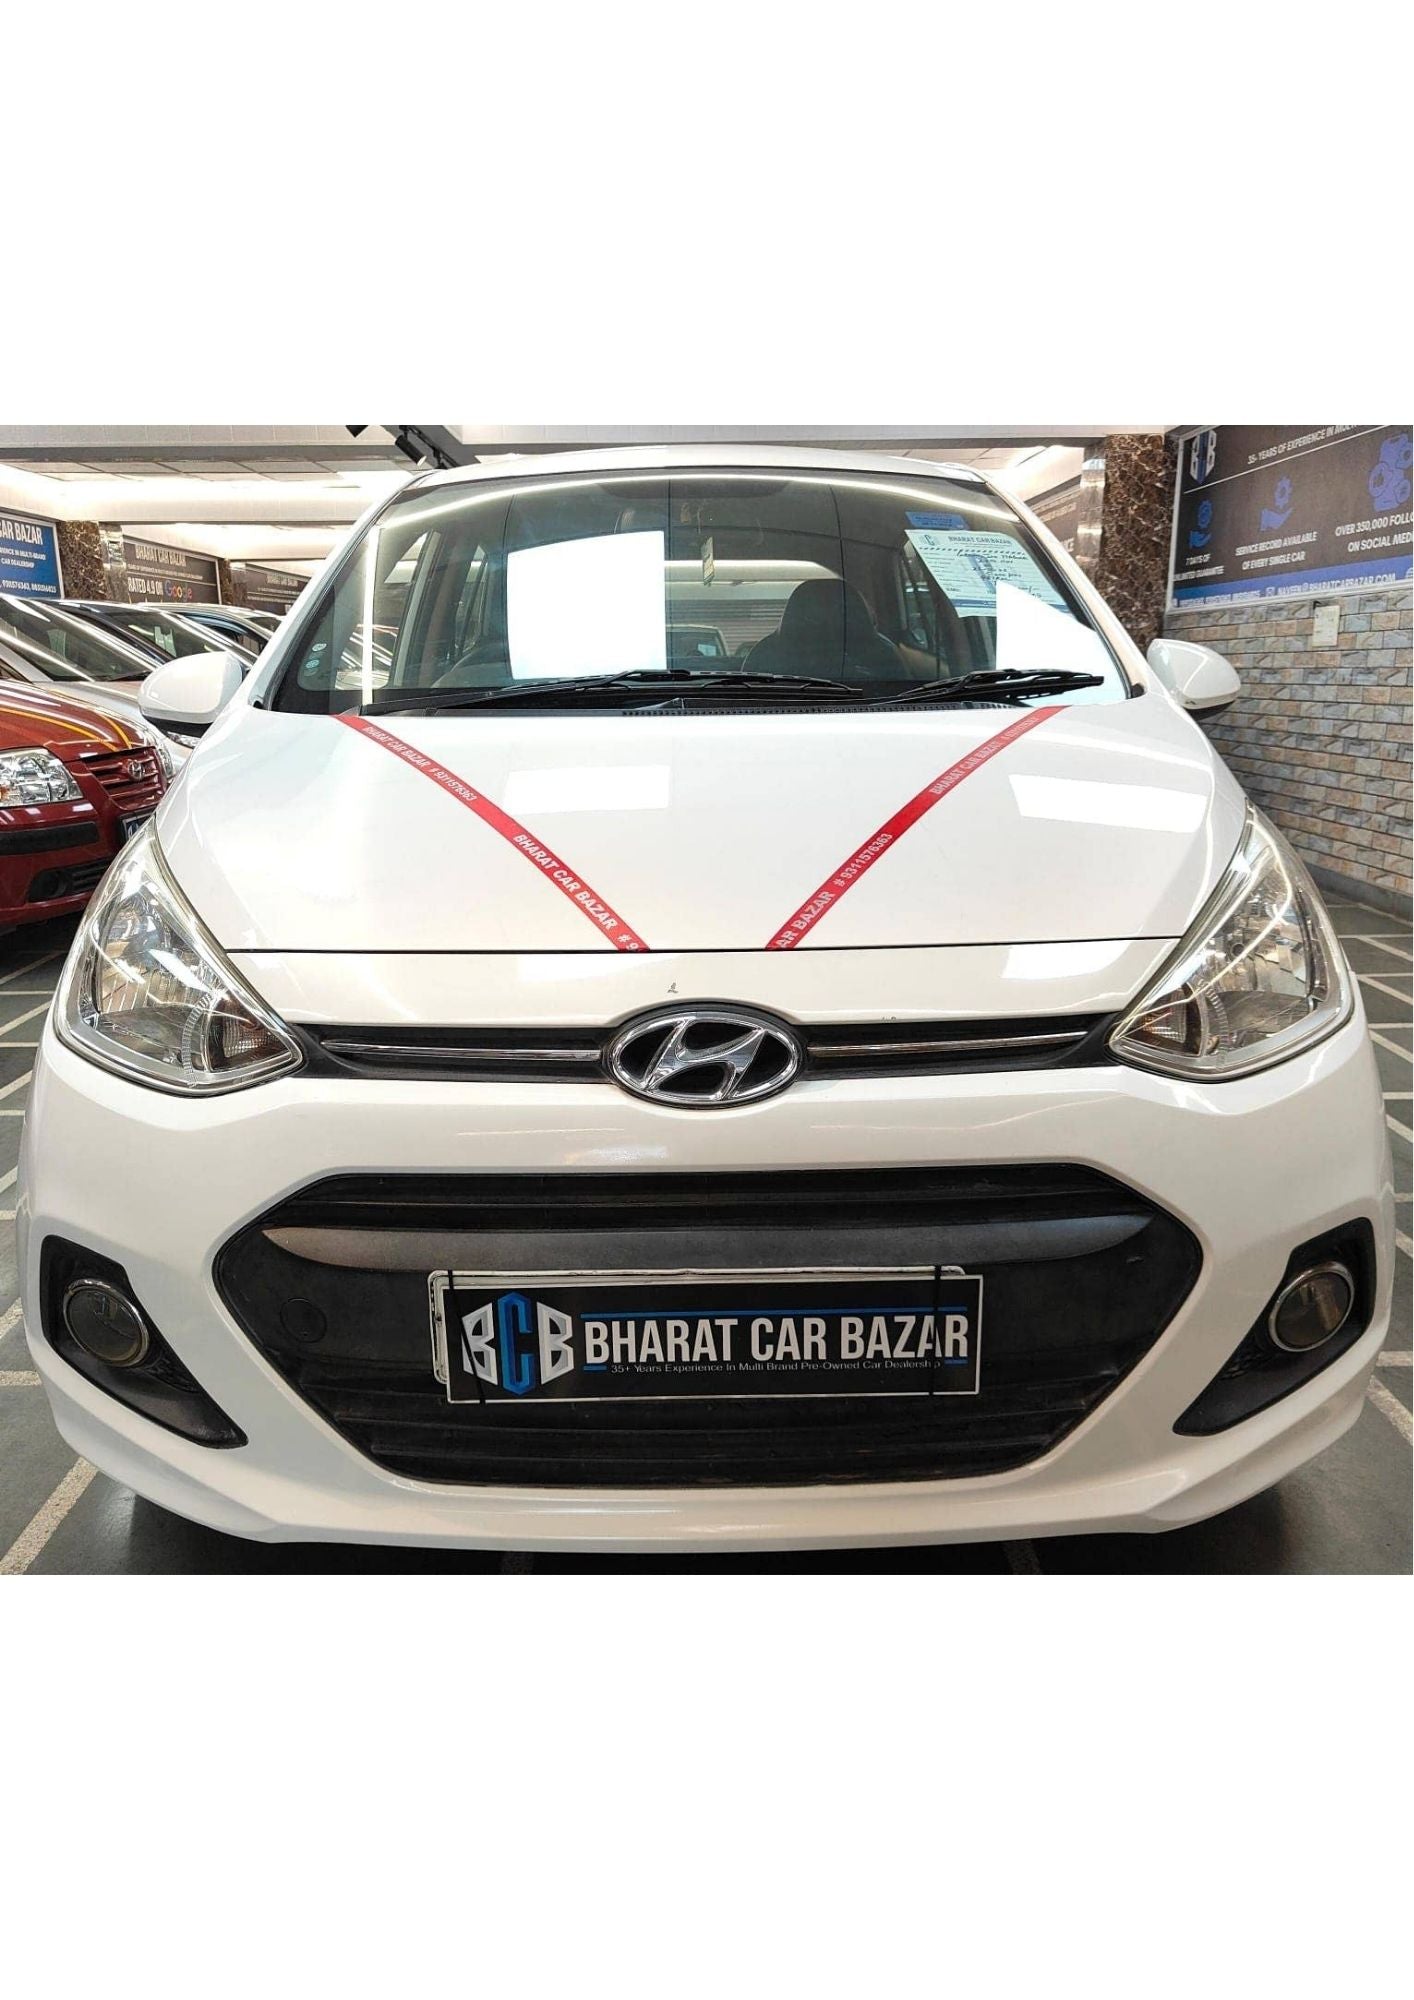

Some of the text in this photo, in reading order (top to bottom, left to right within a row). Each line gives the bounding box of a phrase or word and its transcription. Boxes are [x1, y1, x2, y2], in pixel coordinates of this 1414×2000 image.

[1278, 442, 1287, 454] OF
[1287, 429, 1326, 451] EXPERIENCE
[14, 522, 43, 546] BAZAR
[1335, 523, 1356, 537] OVER
[1356, 517, 1389, 532] 350,000
[1235, 544, 1259, 556] SERVICE
[1282, 531, 1318, 548] AVAILABLE
[1347, 541, 1361, 552] ON
[1360, 536, 1392, 550] SOCIAL
[1268, 553, 1291, 566] SINGLE
[1291, 551, 1306, 562] CAR
[127, 577, 147, 594] RATED
[164, 579, 193, 601] Google
[387, 741, 408, 752] CAR
[400, 749, 431, 767] BAZAR
[929, 767, 965, 795] BHARAT
[514, 834, 559, 870] BHARAT
[552, 869, 581, 893] CAR
[576, 890, 618, 930] BAZAR
[791, 890, 836, 931] BAZAR
[584, 1313, 969, 1364] BHARAT CAR BAZAR
[611, 1359, 941, 1374] 35+ Years Experience In Multi Brand Pre-Owned Car Dealershp
